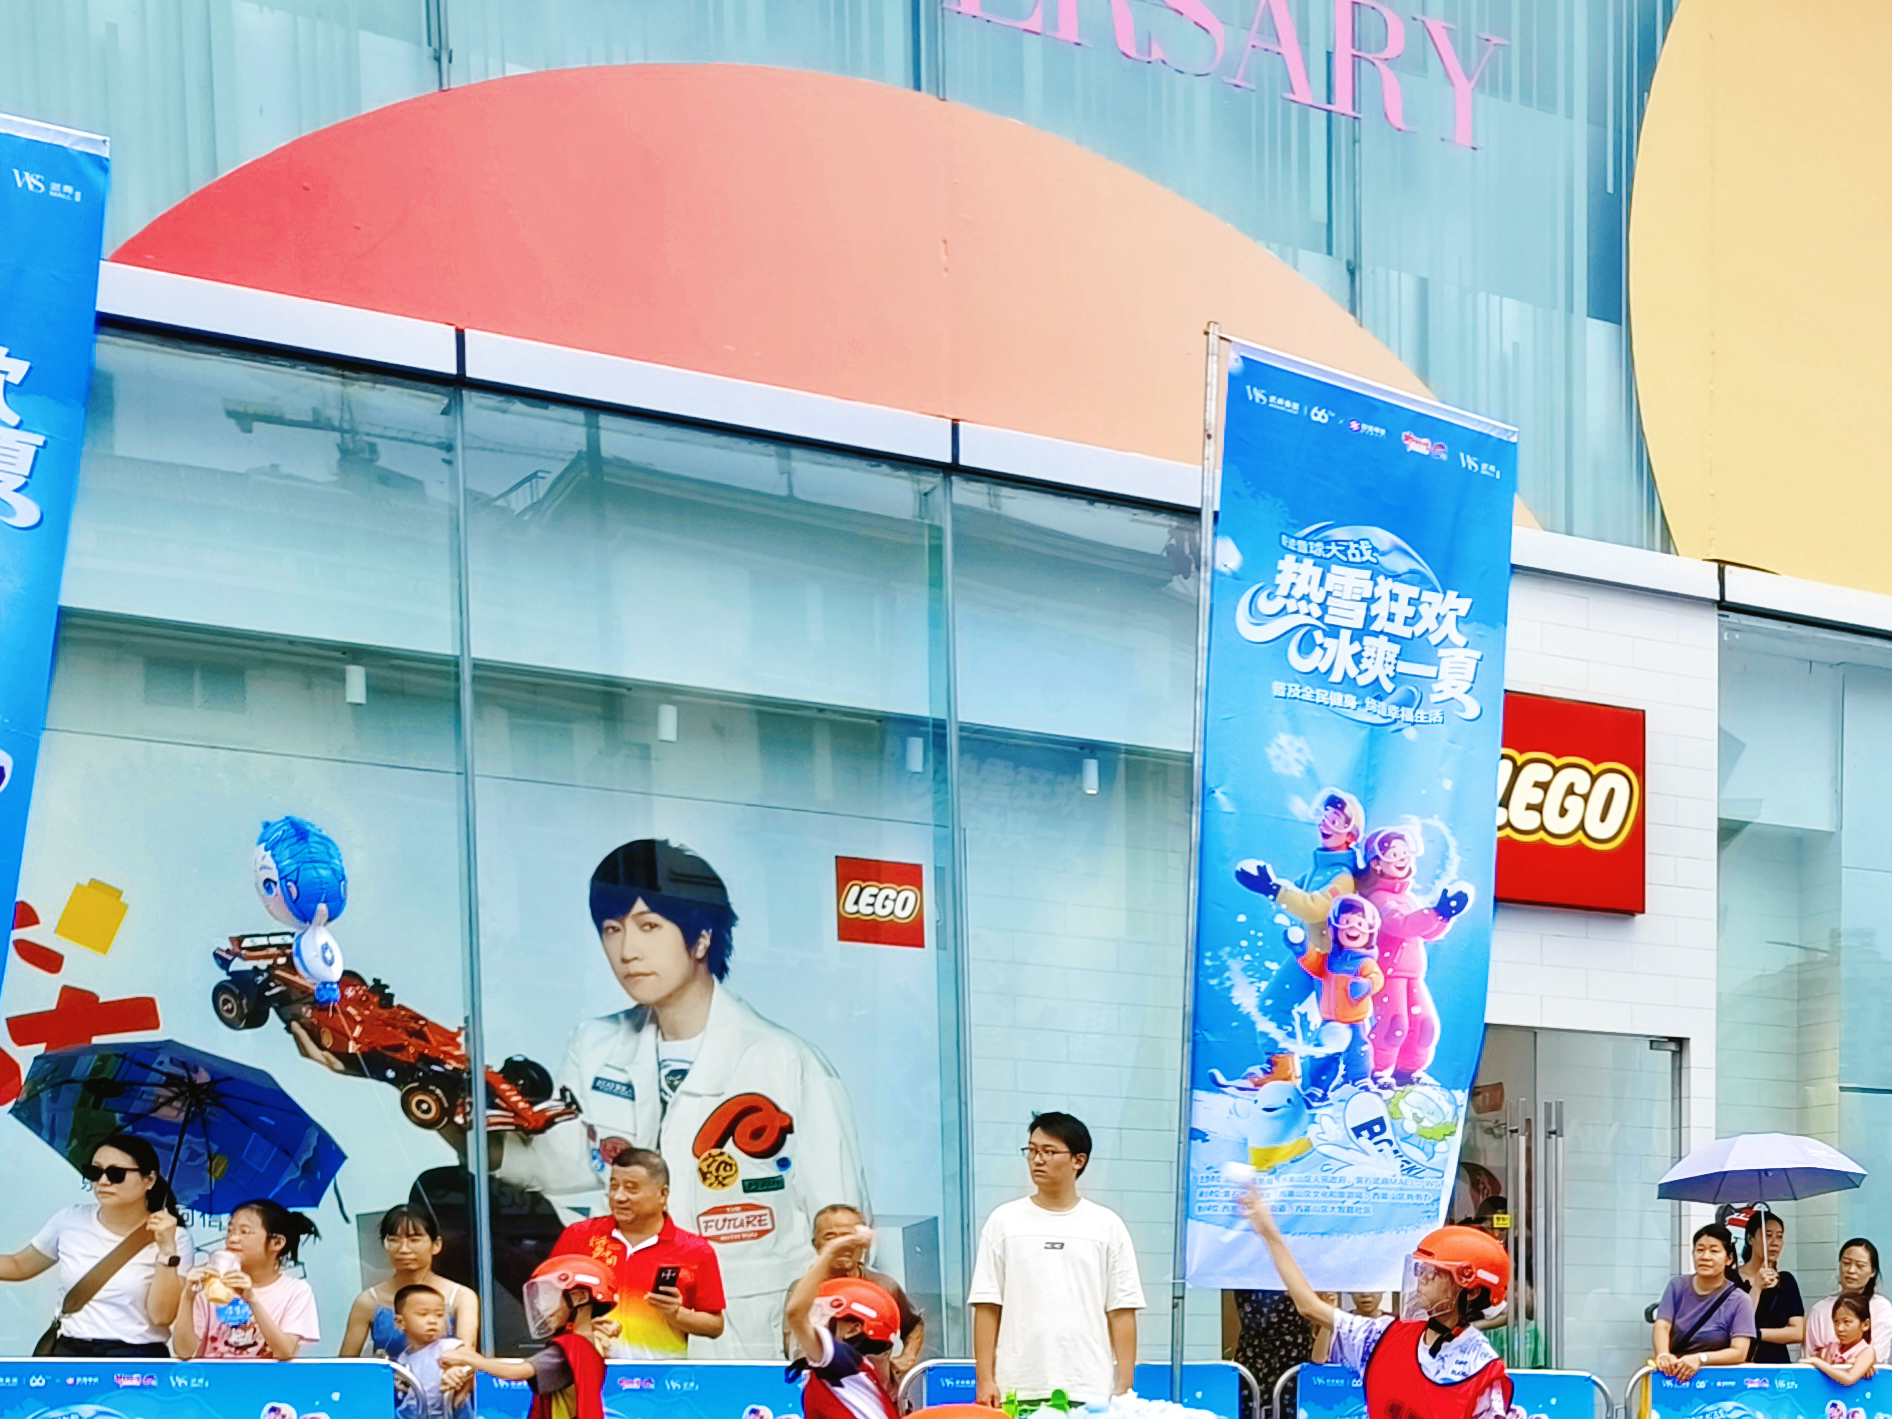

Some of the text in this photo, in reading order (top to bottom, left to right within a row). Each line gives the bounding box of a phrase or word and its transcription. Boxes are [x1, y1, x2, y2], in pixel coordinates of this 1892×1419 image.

[941, 0, 1510, 150] SARY
[1273, 553, 1474, 648] 热雪狂欢
[1287, 628, 1483, 722] 冰爽一夏
[843, 885, 917, 920] LEGO
[703, 1212, 769, 1233] FUTURE
